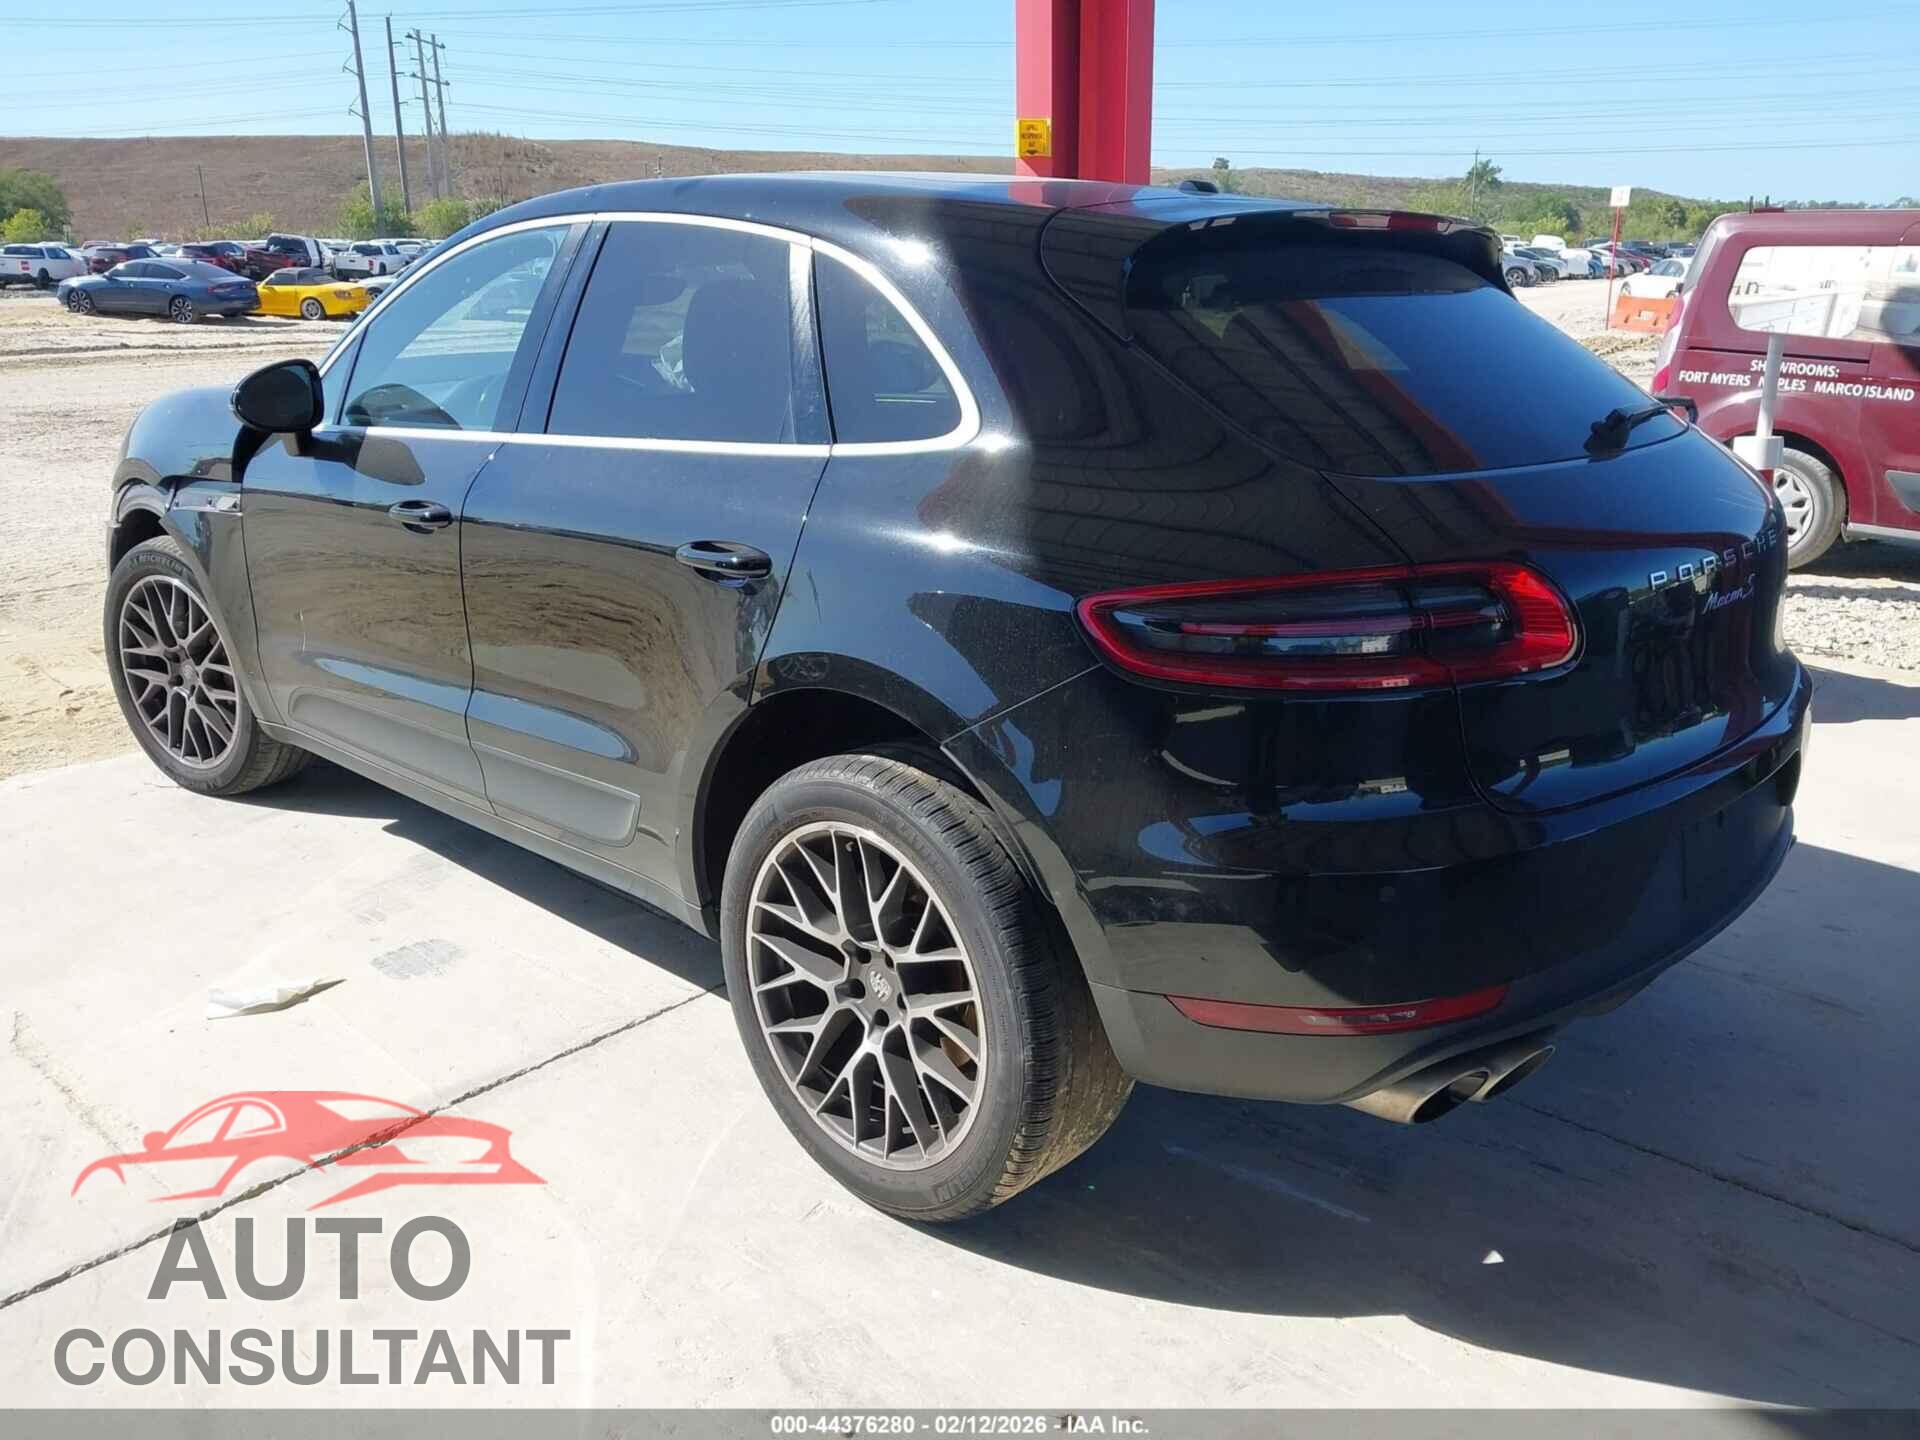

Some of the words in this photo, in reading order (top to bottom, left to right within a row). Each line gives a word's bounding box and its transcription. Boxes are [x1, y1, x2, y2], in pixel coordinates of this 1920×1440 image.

[1750, 359, 1840, 379] SHWROOMS:
[1679, 370, 1709, 385] FORT
[1710, 372, 1751, 387] MYERS
[1758, 375, 1807, 392] NPLES
[1814, 381, 1863, 397] MARCO
[1864, 385, 1915, 401] ISLAND
[1649, 528, 1777, 592] PORSCHE
[1701, 588, 1743, 615] Macan
